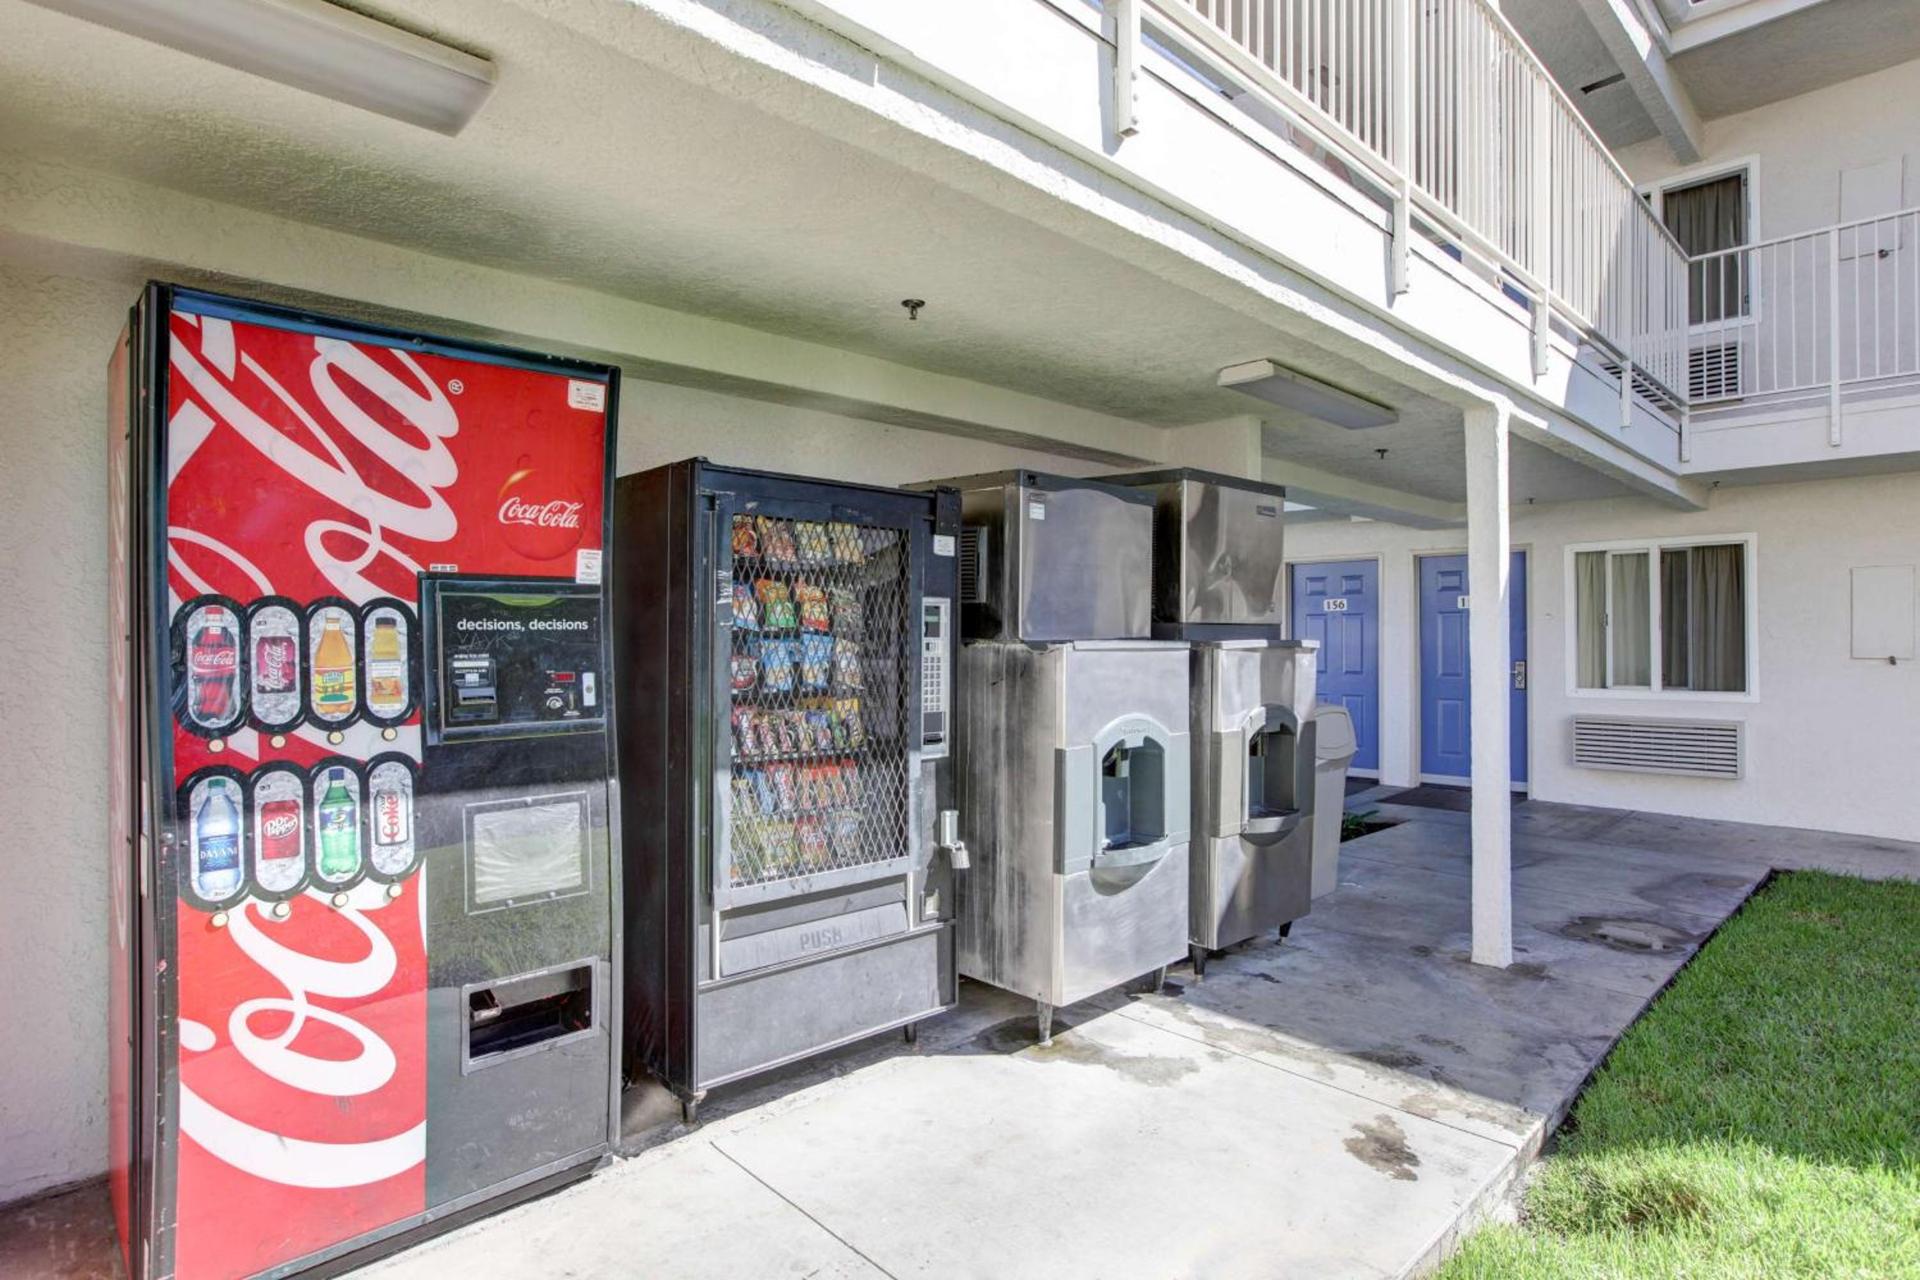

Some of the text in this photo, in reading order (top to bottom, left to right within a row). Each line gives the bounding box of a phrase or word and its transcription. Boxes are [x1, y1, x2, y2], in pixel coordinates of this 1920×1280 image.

[498, 496, 583, 528] Coca-Cola
[1326, 600, 1345, 610] 156
[457, 618, 589, 632] decisions, decisions
[194, 650, 235, 665] Coca-Cola
[382, 793, 400, 842] Coke
[801, 928, 842, 950] PUSH
